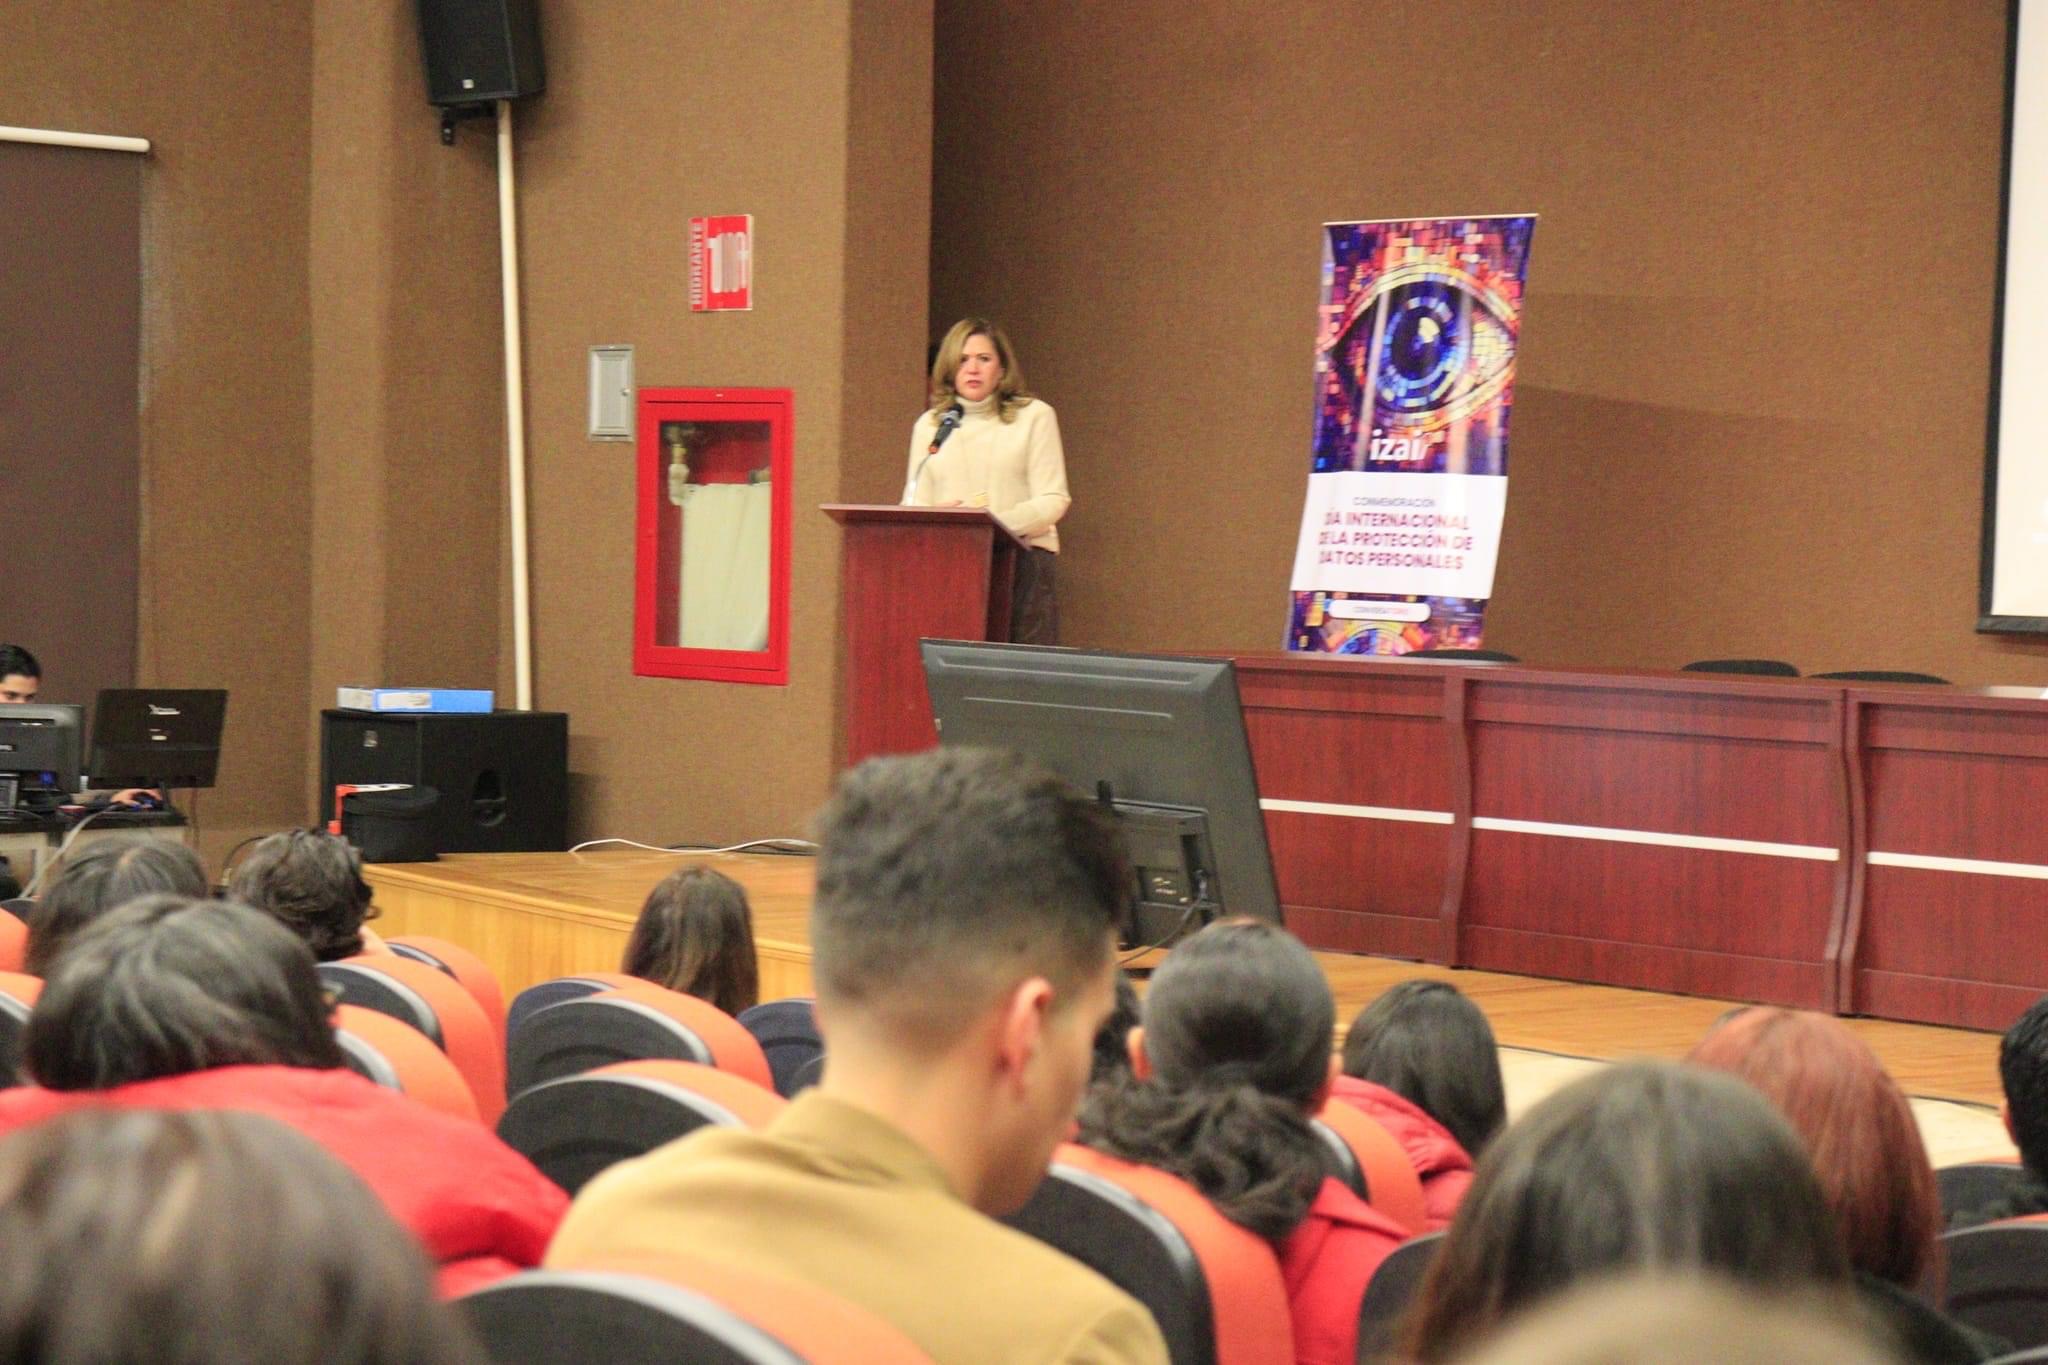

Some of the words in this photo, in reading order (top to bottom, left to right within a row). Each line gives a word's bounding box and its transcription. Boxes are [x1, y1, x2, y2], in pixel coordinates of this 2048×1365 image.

[690, 223, 703, 305] HIDRANTE
[1346, 512, 1469, 530] INTERNACIONAL
[1354, 530, 1447, 549] PROTECCIÓN
[1453, 535, 1473, 550] DE
[1368, 552, 1465, 569] PERSONALES
